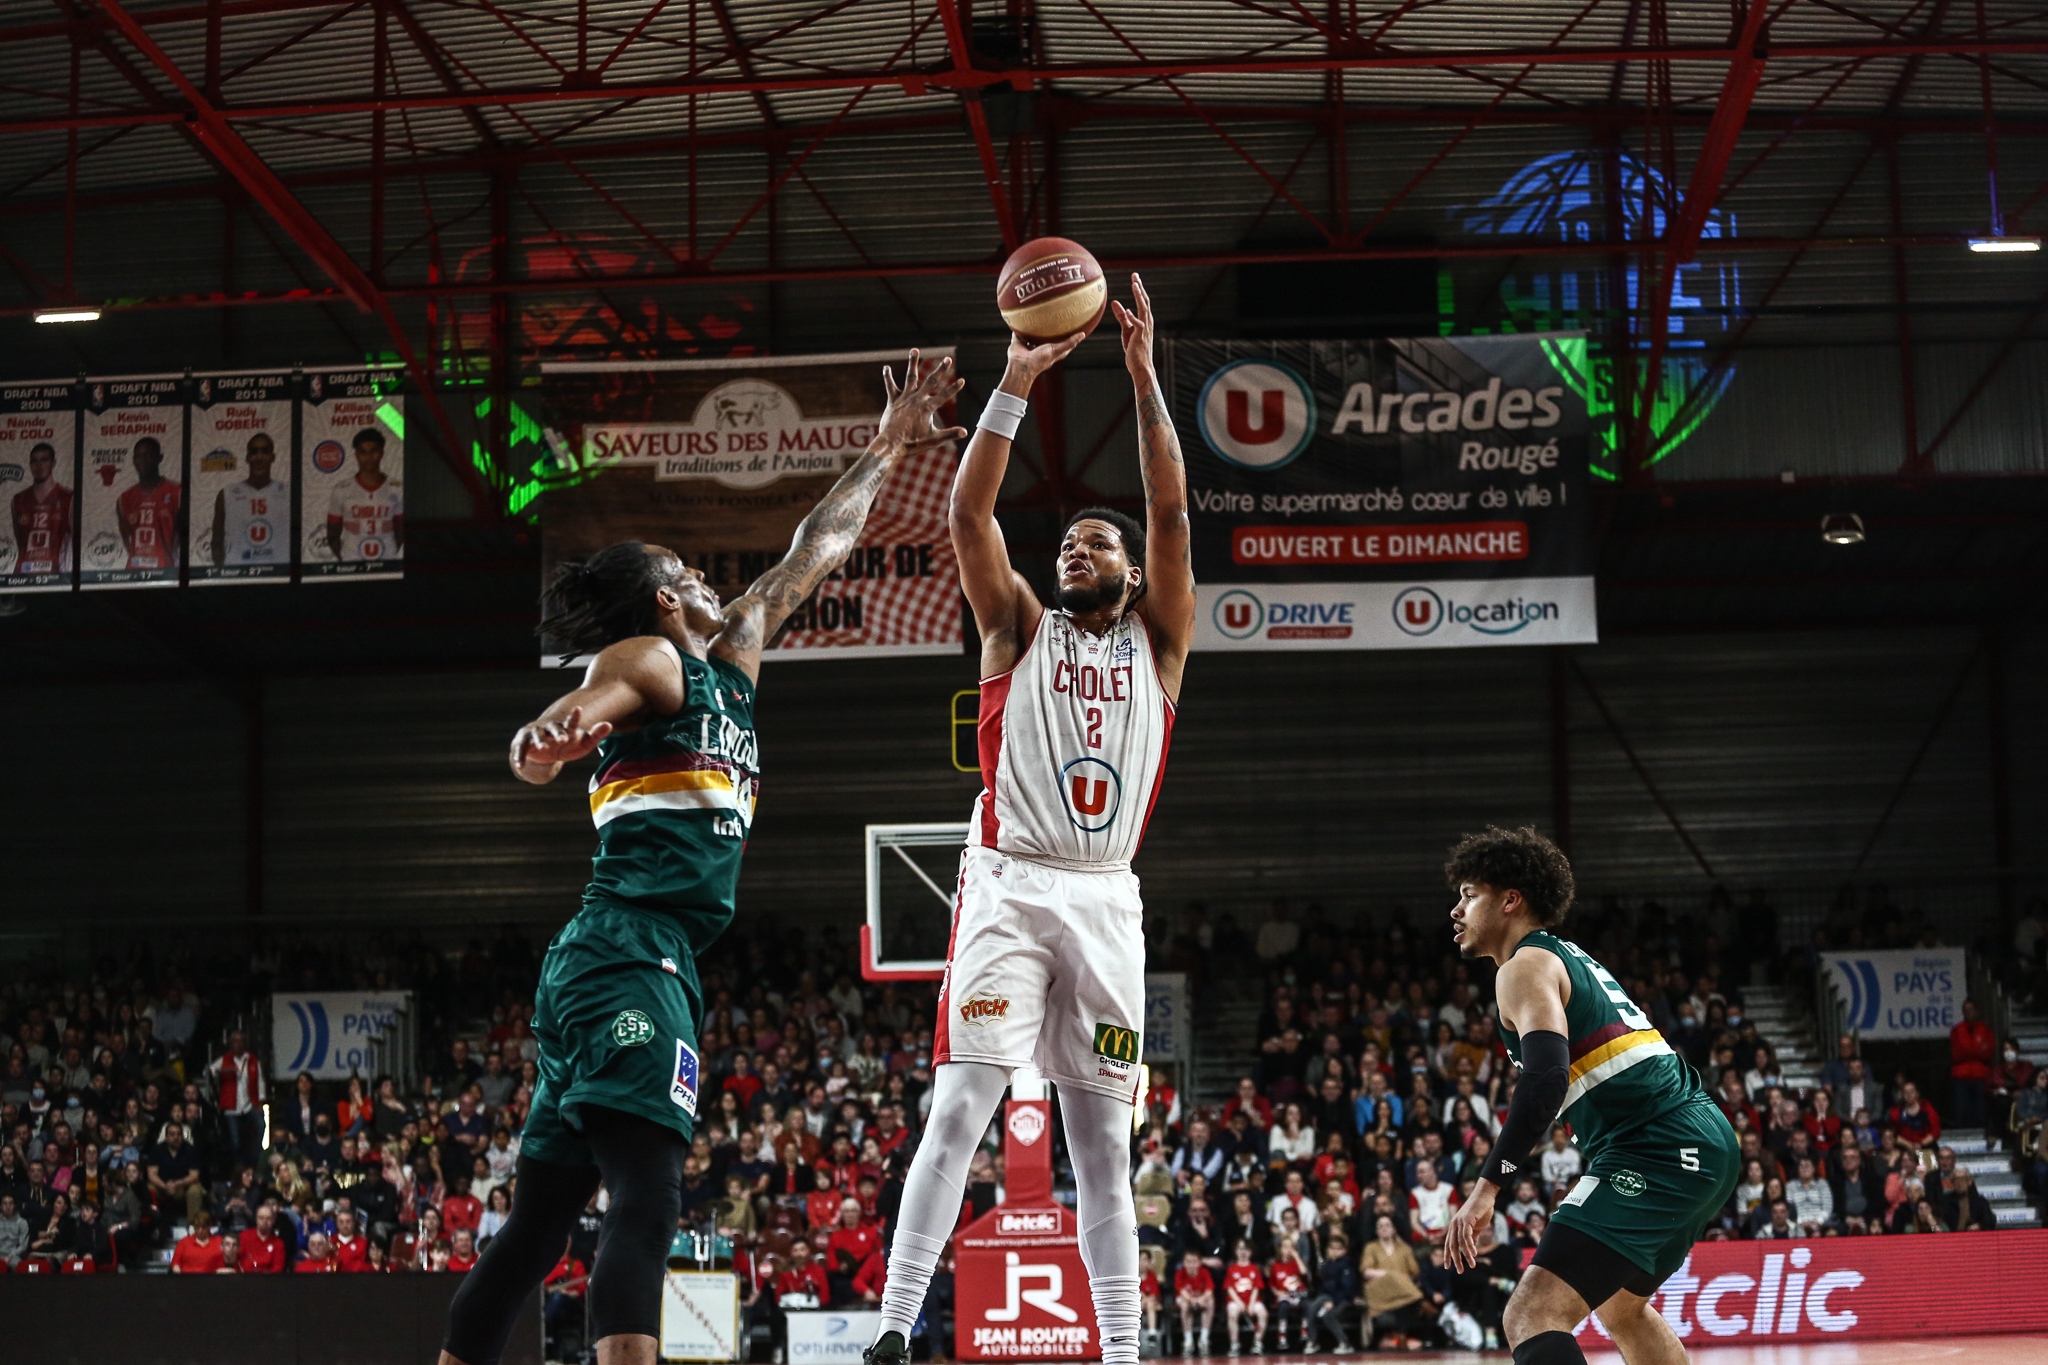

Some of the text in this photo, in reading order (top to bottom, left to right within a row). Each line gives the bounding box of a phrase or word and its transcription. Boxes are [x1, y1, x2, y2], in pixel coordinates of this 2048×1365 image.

[218, 377, 284, 389] DRAFT NBA
[328, 372, 396, 385] DRAFT NBA
[4, 387, 68, 399] DRAFT NBA
[111, 382, 176, 394] DRAFT NBA
[235, 389, 266, 400] 2013
[128, 394, 158, 405] 2010
[334, 403, 372, 413] Killian
[1331, 377, 1563, 435] Arcades
[118, 413, 149, 422] Kevin
[226, 406, 257, 418] Rudy
[331, 414, 375, 426] HAYES
[1226, 390, 1286, 446] U
[7, 417, 46, 428] Nando
[101, 423, 166, 436] SERAPHIN
[215, 418, 267, 431] GOBERT
[0, 428, 53, 441] DE COLO
[592, 430, 718, 459] SAVEURS
[727, 431, 769, 452] DES
[665, 453, 833, 475] traditions de l'Anjou
[1458, 438, 1560, 475] Rougé
[250, 498, 267, 515] 15
[1193, 489, 1255, 512] Votre
[1261, 486, 1404, 517] supermarché
[1412, 490, 1469, 510] cœur
[1479, 485, 1508, 507] de
[1514, 483, 1552, 507] ville
[33, 512, 48, 528] 12
[250, 525, 267, 542] U
[364, 543, 380, 557] U
[1240, 531, 1523, 558] OUVERT LE DIMANCHE
[895, 543, 935, 578] DE
[1225, 603, 1251, 629] U
[1267, 602, 1356, 625] DRIVE
[1405, 600, 1431, 625] U
[1448, 594, 1559, 624] location
[1053, 659, 1133, 702] CHOLET
[1086, 707, 1103, 749] 2
[1072, 775, 1107, 816] U
[1894, 971, 1953, 994] PAYS
[1887, 1006, 1954, 1029] LOIRE
[618, 1017, 649, 1037] CSP
[1099, 1056, 1130, 1070] CHOLET
[1097, 1068, 1127, 1083] SPALDING
[673, 1085, 696, 1106] PHI
[1680, 1147, 1700, 1173] 5
[1001, 1214, 1056, 1231] Betclic
[973, 1326, 1089, 1347] JEAN ROUYER
[980, 1343, 1083, 1356] AUTOMOBILES
